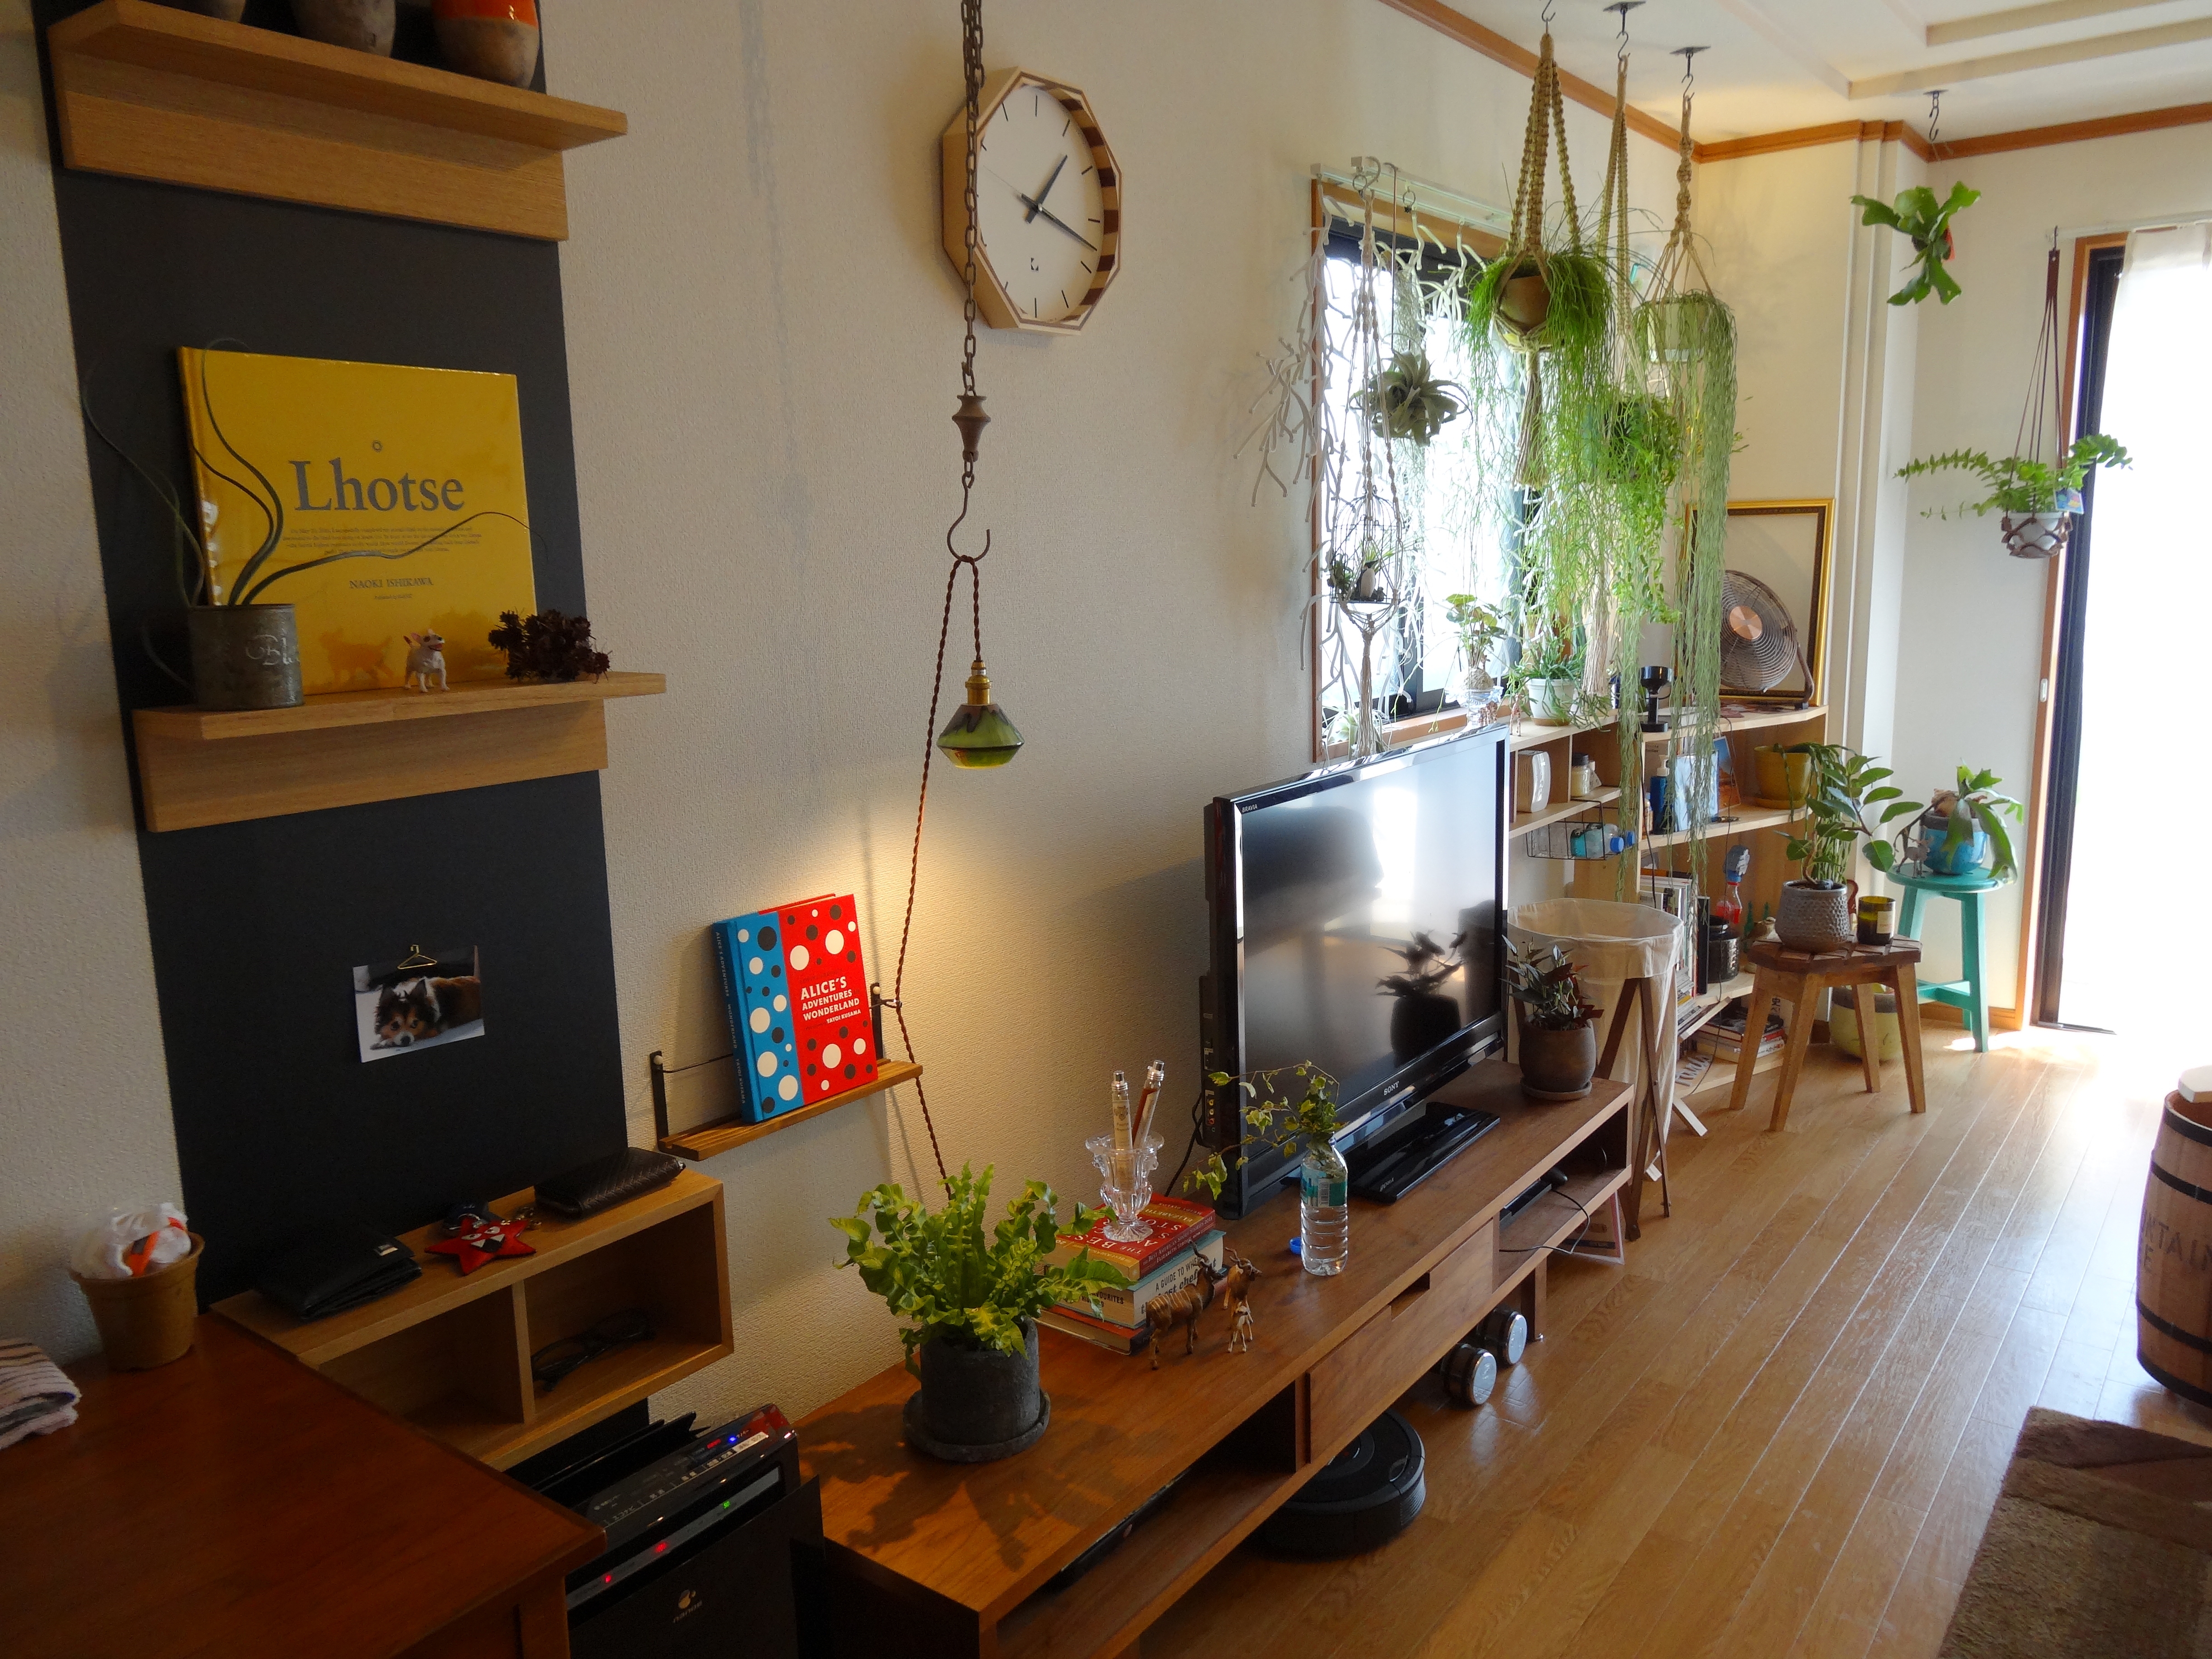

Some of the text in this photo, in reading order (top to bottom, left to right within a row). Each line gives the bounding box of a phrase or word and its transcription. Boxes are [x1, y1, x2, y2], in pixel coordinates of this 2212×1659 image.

[288, 457, 464, 511] Lhotse
[349, 577, 434, 589] NAOKI ISHIKAWA
[1242, 804, 1258, 813] BRAVIA
[801, 976, 847, 1000] ALICE'S
[802, 989, 853, 1011] ADVENTURES
[803, 998, 860, 1021] WONDERLAND
[826, 1009, 862, 1024] YAYOI KUSAMA
[1383, 1081, 1400, 1096] SONY
[1065, 1234, 1117, 1249] BES
[1156, 1282, 1159, 1292] A
[1161, 1272, 1176, 1288] GUIDE
[1177, 1266, 1184, 1277] TO
[1185, 1257, 1198, 1272] WHE
[1179, 1269, 1198, 1289] chef
